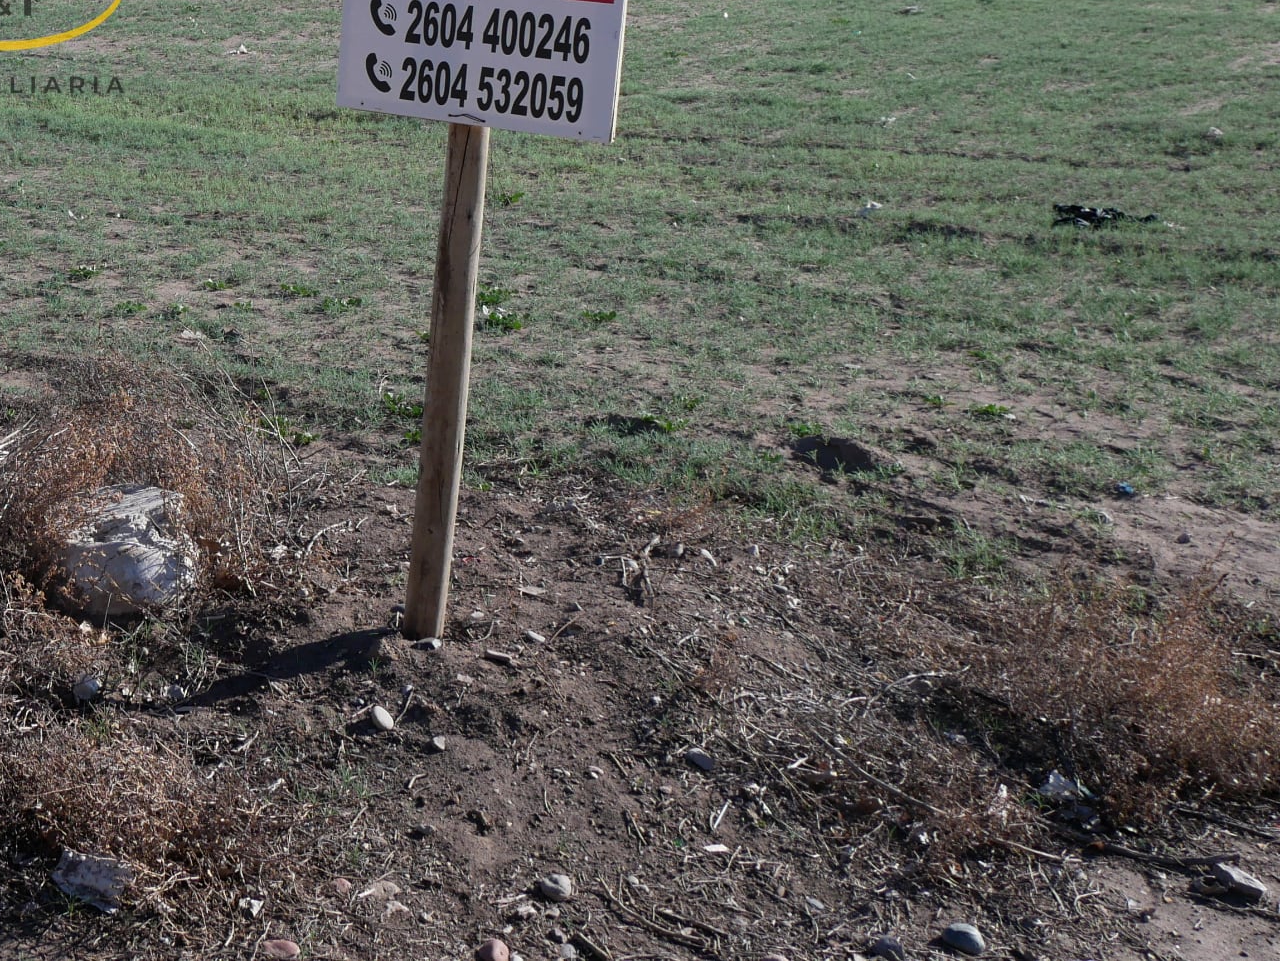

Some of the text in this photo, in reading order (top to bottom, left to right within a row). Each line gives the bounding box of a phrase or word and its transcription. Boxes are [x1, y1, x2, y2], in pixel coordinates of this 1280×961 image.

[404, 0, 591, 64] 2604 400246
[399, 57, 584, 123] 2604 532059
